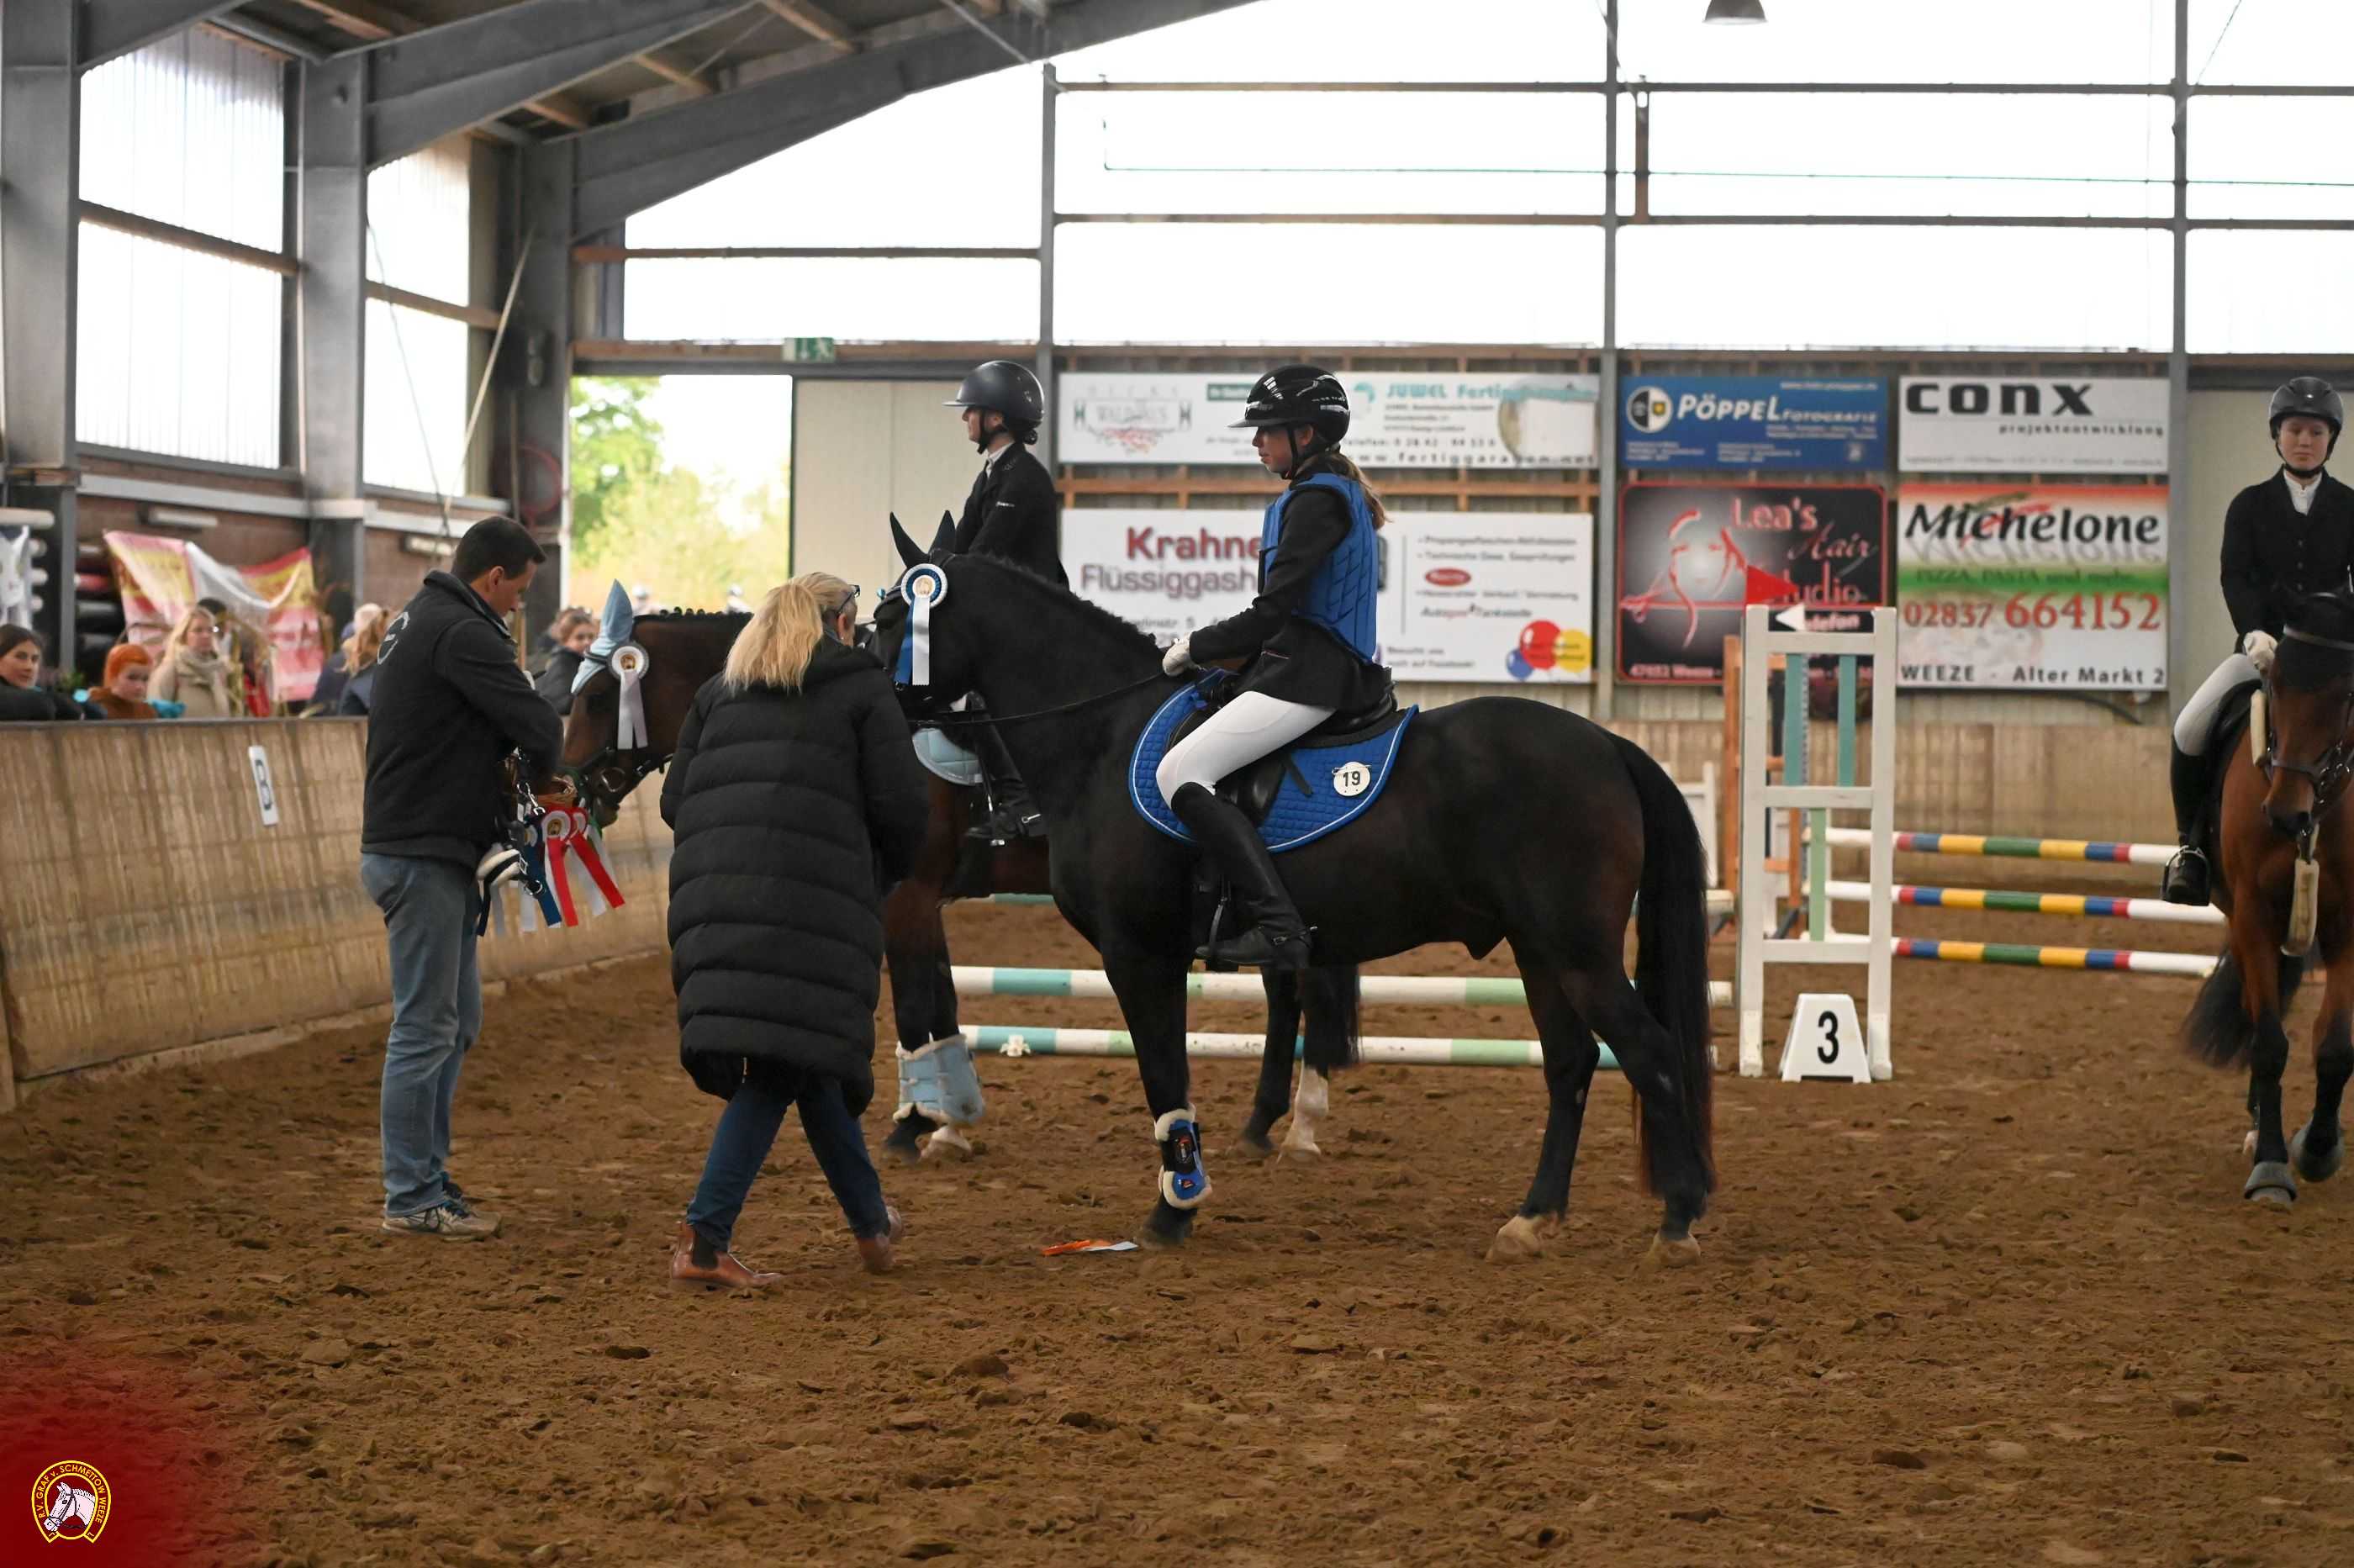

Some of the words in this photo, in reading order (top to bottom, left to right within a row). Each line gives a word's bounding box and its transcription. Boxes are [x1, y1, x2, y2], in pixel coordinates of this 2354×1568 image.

[1387, 383, 1448, 398] JUWEL
[1906, 383, 2093, 416] conx
[1732, 496, 1819, 531] Lea's
[1904, 502, 2160, 545] Michelone
[1127, 526, 1262, 561] Krahne
[1081, 562, 1258, 599] Flüssiggash
[1903, 601, 1993, 629] 02837
[2004, 591, 2161, 631] 664152
[1901, 664, 1975, 682] WEEZE
[2013, 666, 2070, 684] Alter
[2077, 667, 2143, 684] Markt
[2154, 668, 2165, 684] 2
[1343, 770, 1361, 787] 19
[1818, 1011, 1839, 1064] 3
